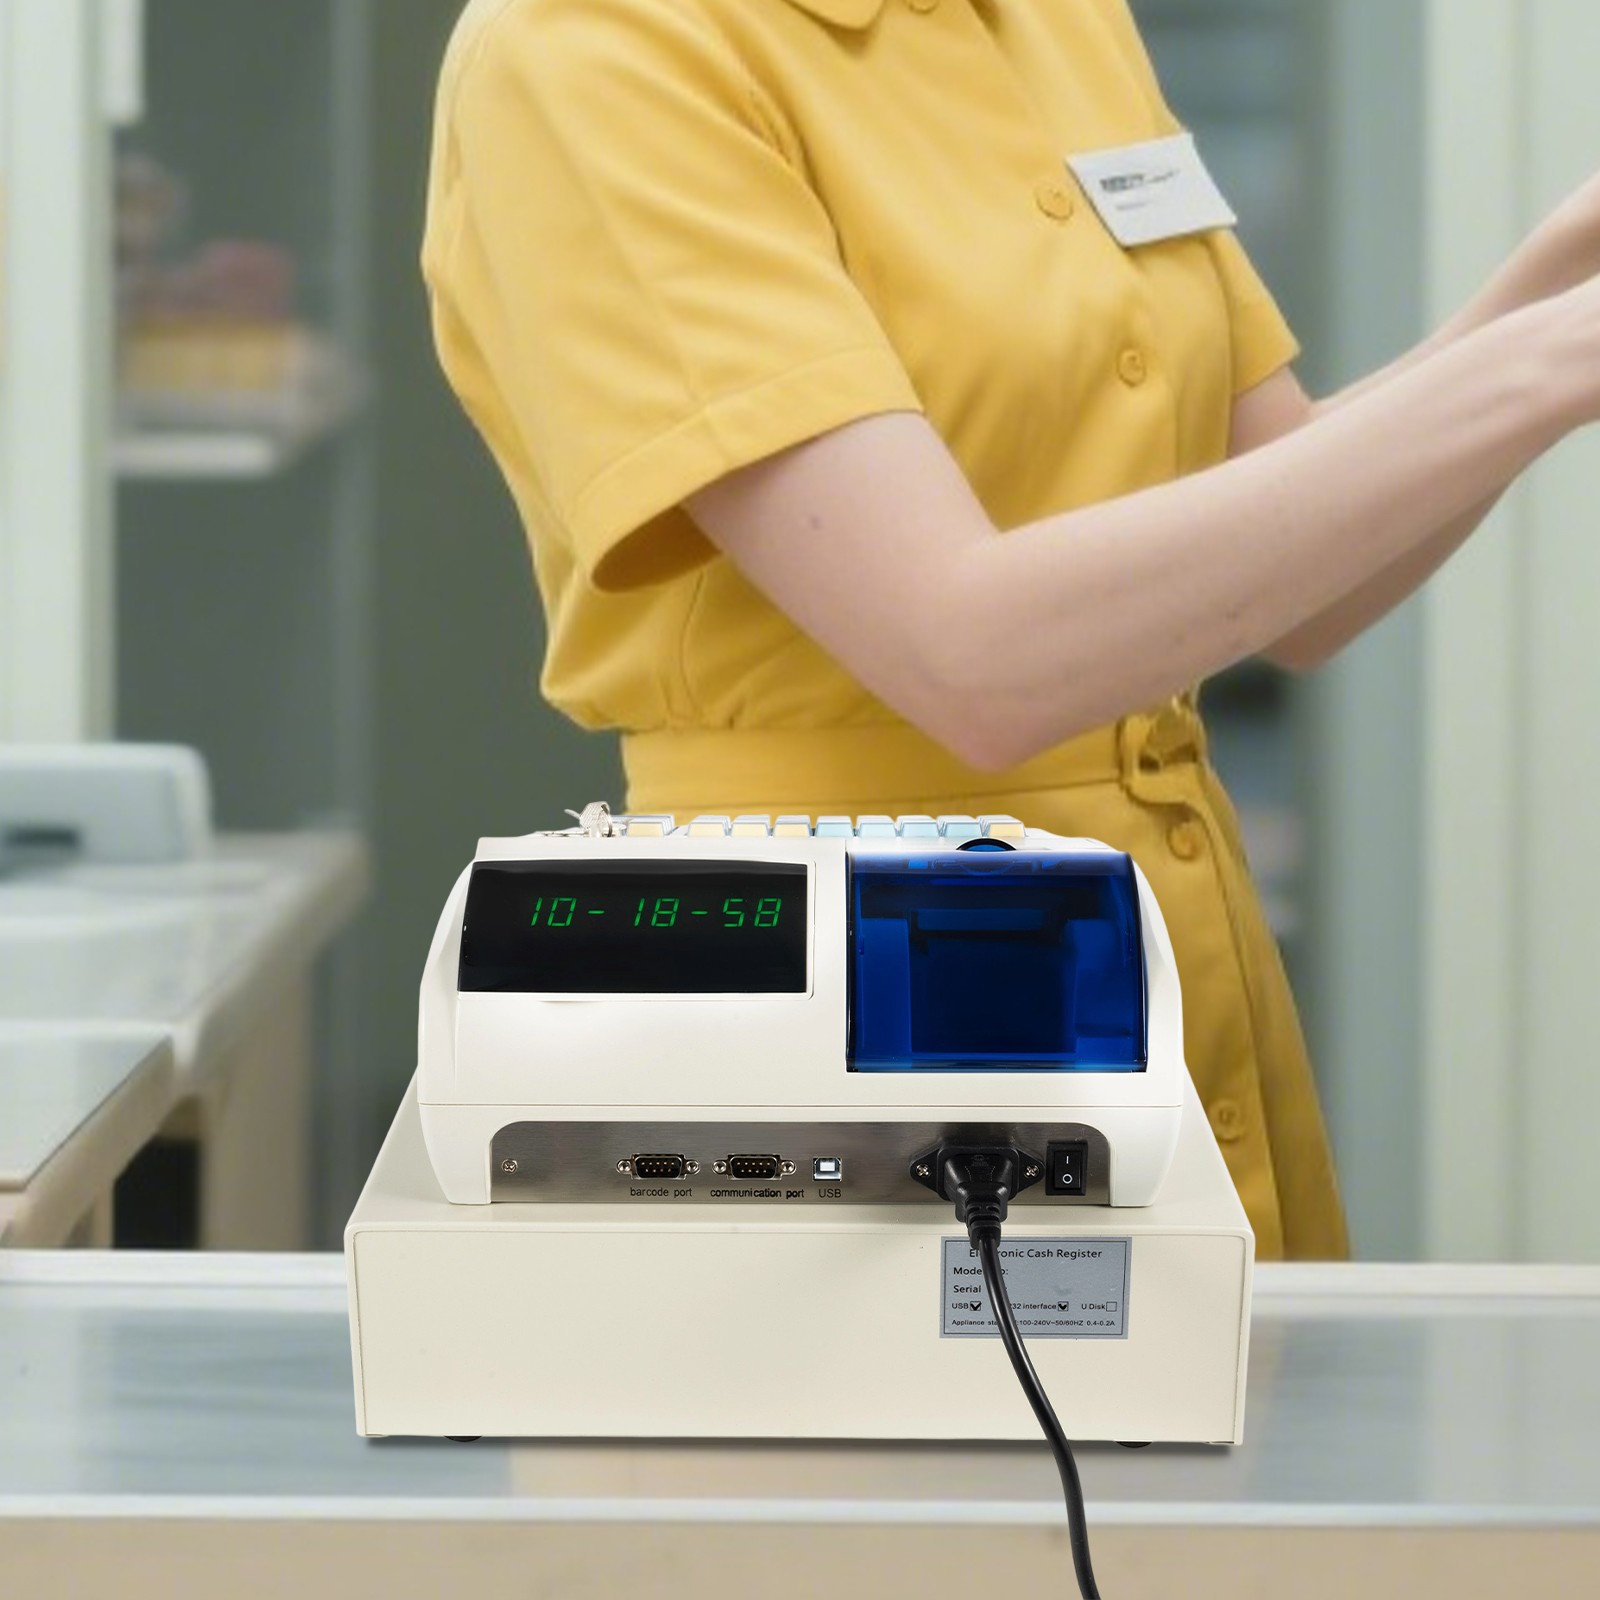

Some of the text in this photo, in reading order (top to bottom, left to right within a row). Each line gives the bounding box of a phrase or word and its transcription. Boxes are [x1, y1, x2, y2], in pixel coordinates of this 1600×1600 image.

[629, 1186, 693, 1199] barcode port
[710, 1186, 805, 1199] communication port
[818, 1188, 842, 1198] USB
[1027, 1248, 1054, 1258] Cash
[1057, 1248, 1103, 1260] Register
[953, 1266, 983, 1276] Mode
[953, 1284, 982, 1294] Serial
[951, 1302, 969, 1310] USB
[1022, 1301, 1057, 1310] interface
[1088, 1302, 1106, 1310] Disk
